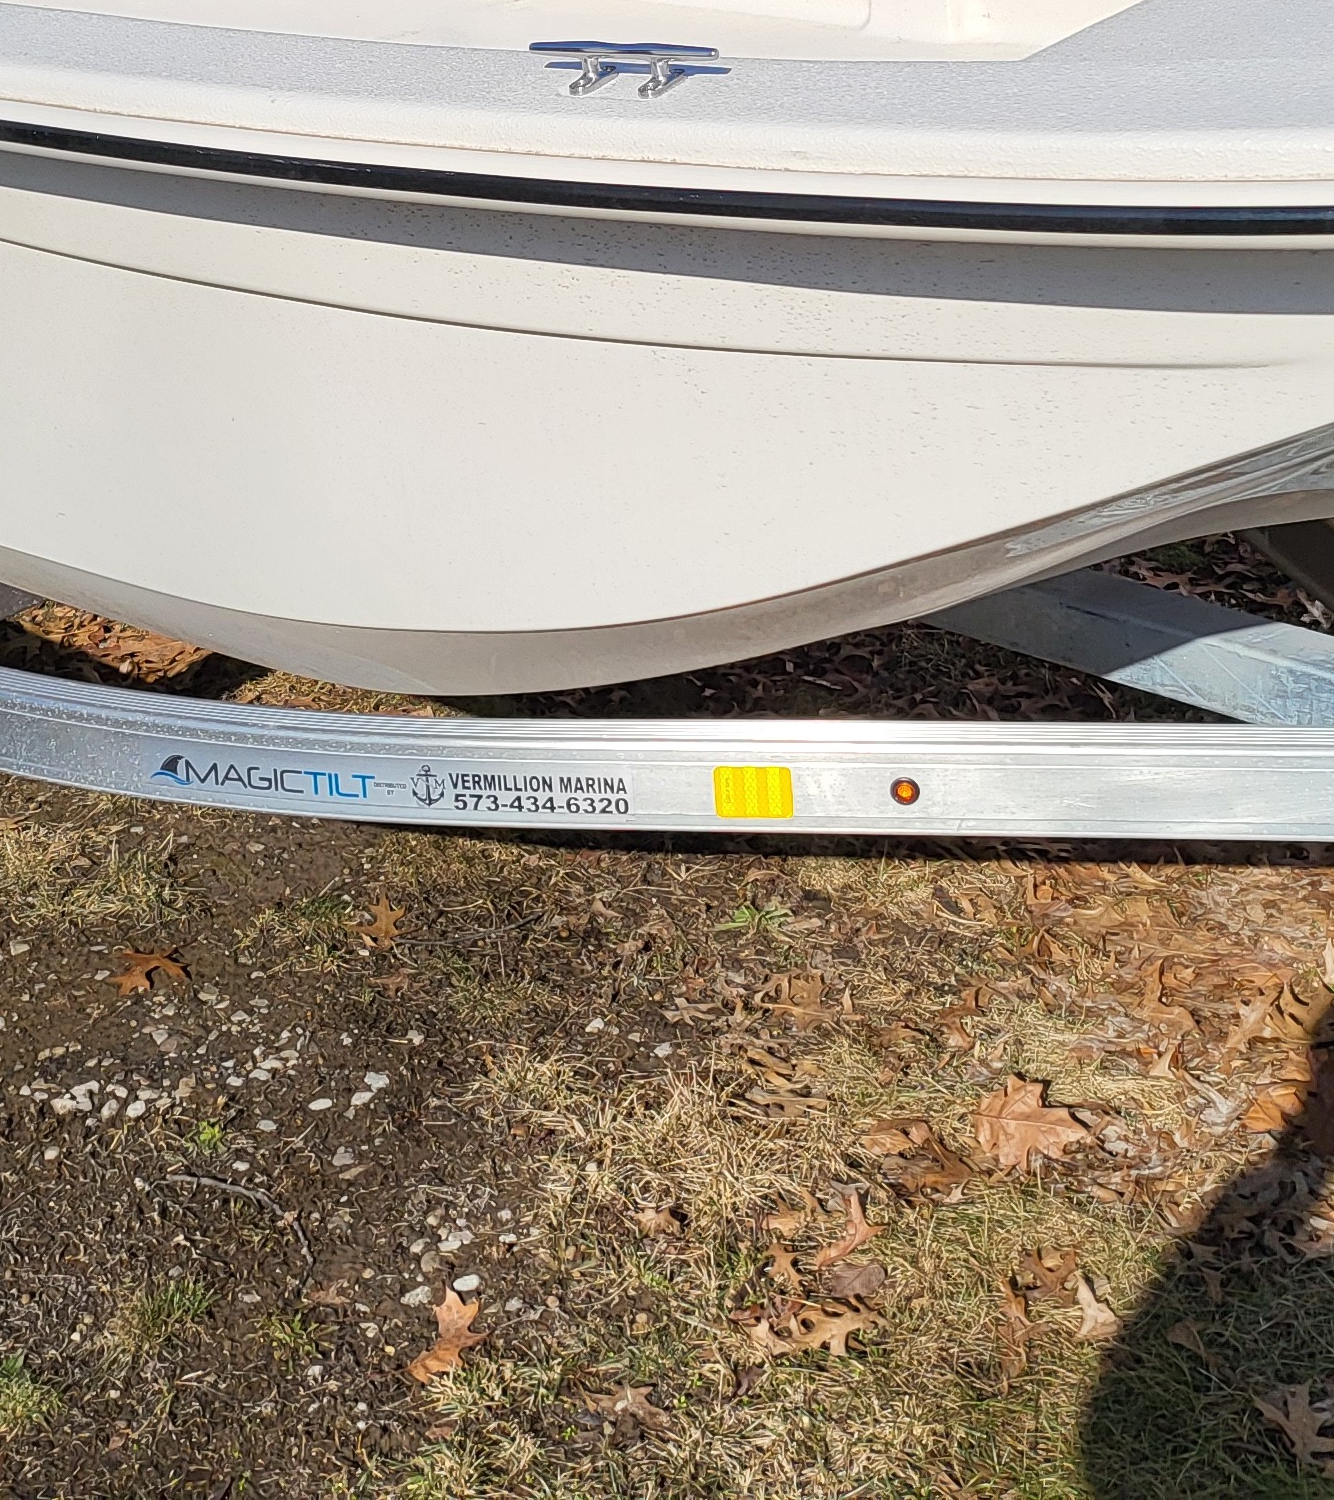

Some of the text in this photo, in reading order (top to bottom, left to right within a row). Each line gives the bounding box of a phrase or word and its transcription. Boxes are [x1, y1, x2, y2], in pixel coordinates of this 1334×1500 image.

[184, 758, 375, 799] MAGICTILT
[448, 772, 628, 795] VERMILLION MARINA
[453, 793, 629, 815] 573-434-6320
